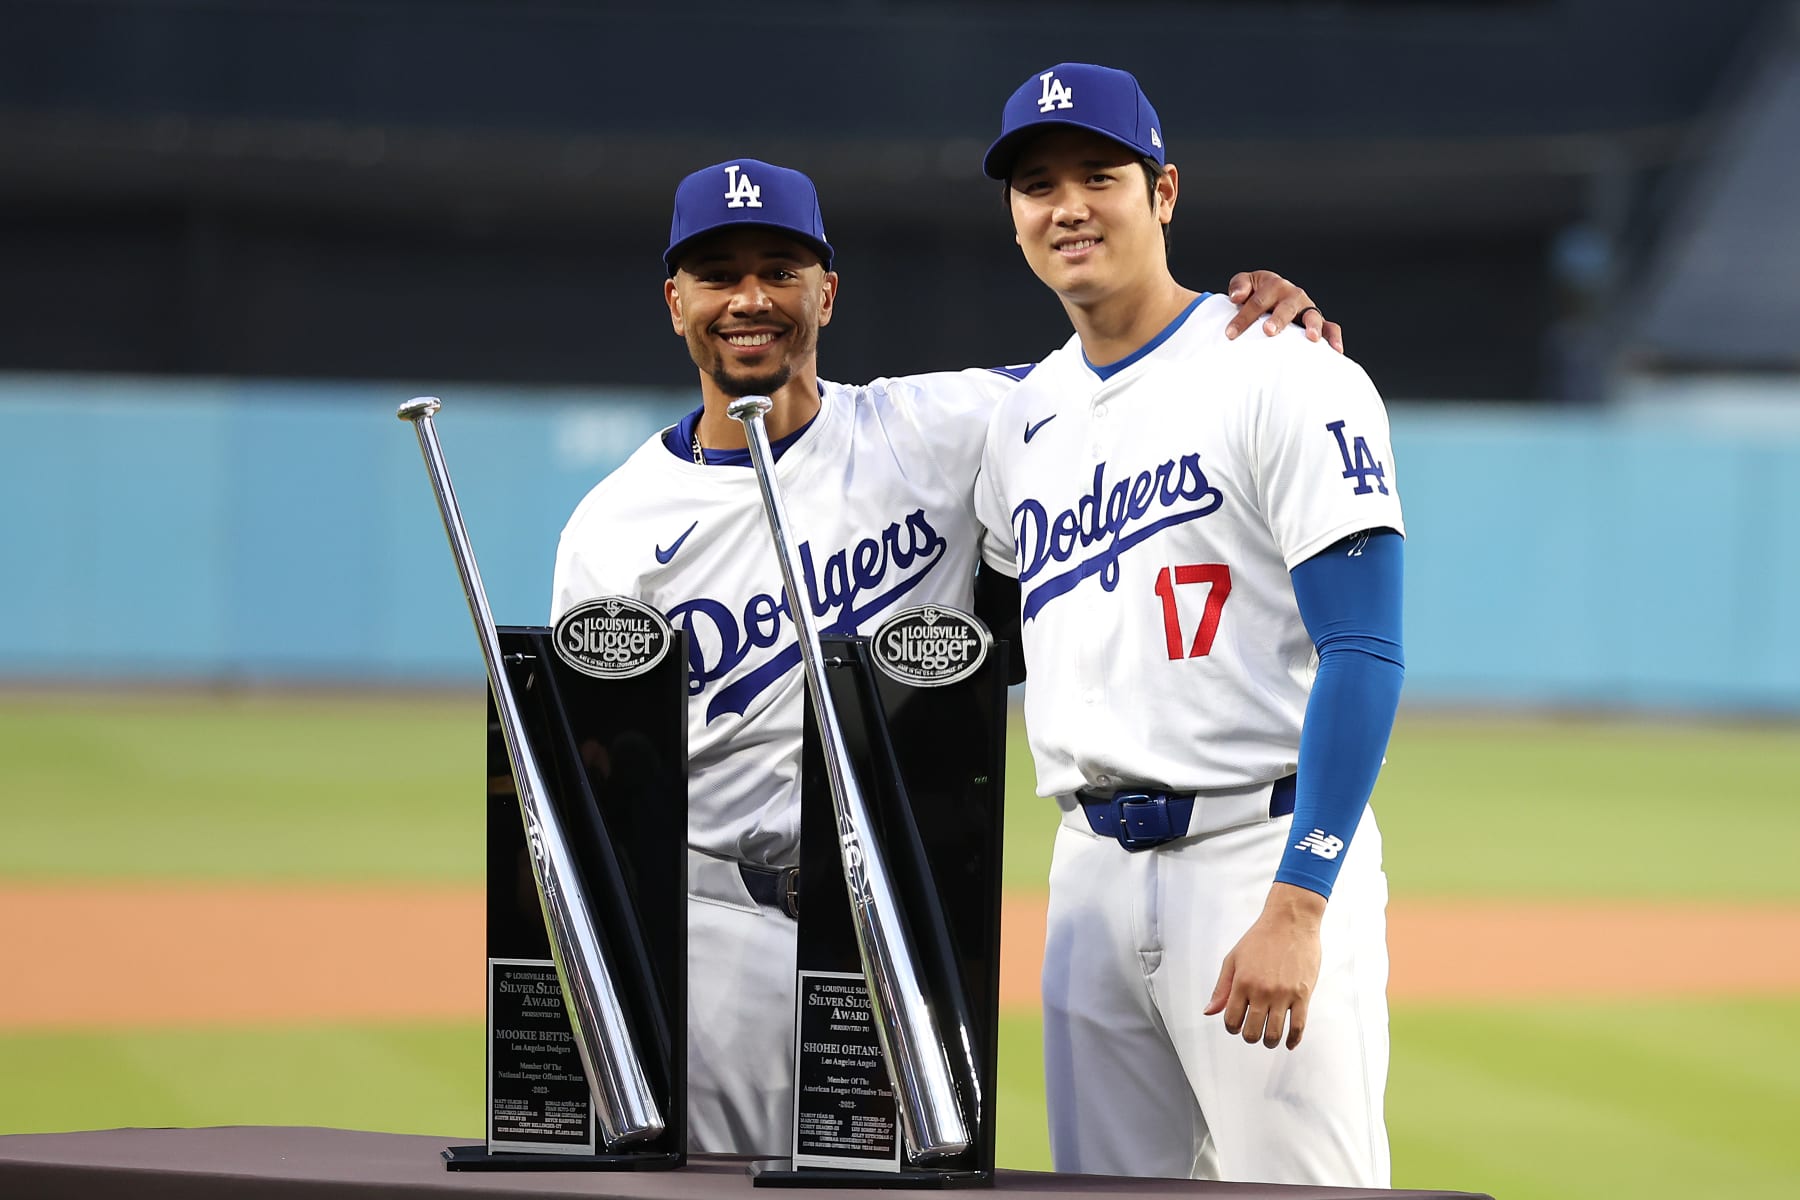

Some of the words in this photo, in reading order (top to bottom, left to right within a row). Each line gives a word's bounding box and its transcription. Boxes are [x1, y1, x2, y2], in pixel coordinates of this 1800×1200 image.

[1037, 71, 1073, 113] LA
[724, 165, 762, 208] LA
[1326, 420, 1389, 495] LA
[1012, 453, 1223, 608] Dodgers
[1155, 564, 1232, 660] 17
[590, 618, 650, 632] LOUISVILLE
[908, 625, 968, 639] LOUISVILLE
[568, 618, 656, 662] Slugger
[887, 627, 973, 670] Slugger
[500, 981, 535, 993] SILVER
[536, 982, 562, 995] SLUG
[822, 985, 855, 993] LOUISVILLE
[522, 995, 560, 1007] AWARD
[808, 993, 844, 1007] SILVER
[845, 995, 871, 1009] SLUG
[831, 1007, 869, 1021] AWARD
[830, 1024, 861, 1032] PRESENTED
[496, 1030, 537, 1040] MOOKIE
[539, 1031, 574, 1041] BETTS-
[803, 1042, 840, 1054] SHOHEI
[841, 1044, 883, 1057] OHTANI-
[821, 1057, 832, 1065] Los
[832, 1058, 856, 1067] Angeles
[856, 1059, 877, 1069] Angels
[827, 1076, 849, 1084] Member
[831, 1086, 851, 1095] League
[851, 1088, 877, 1096] Offensive
